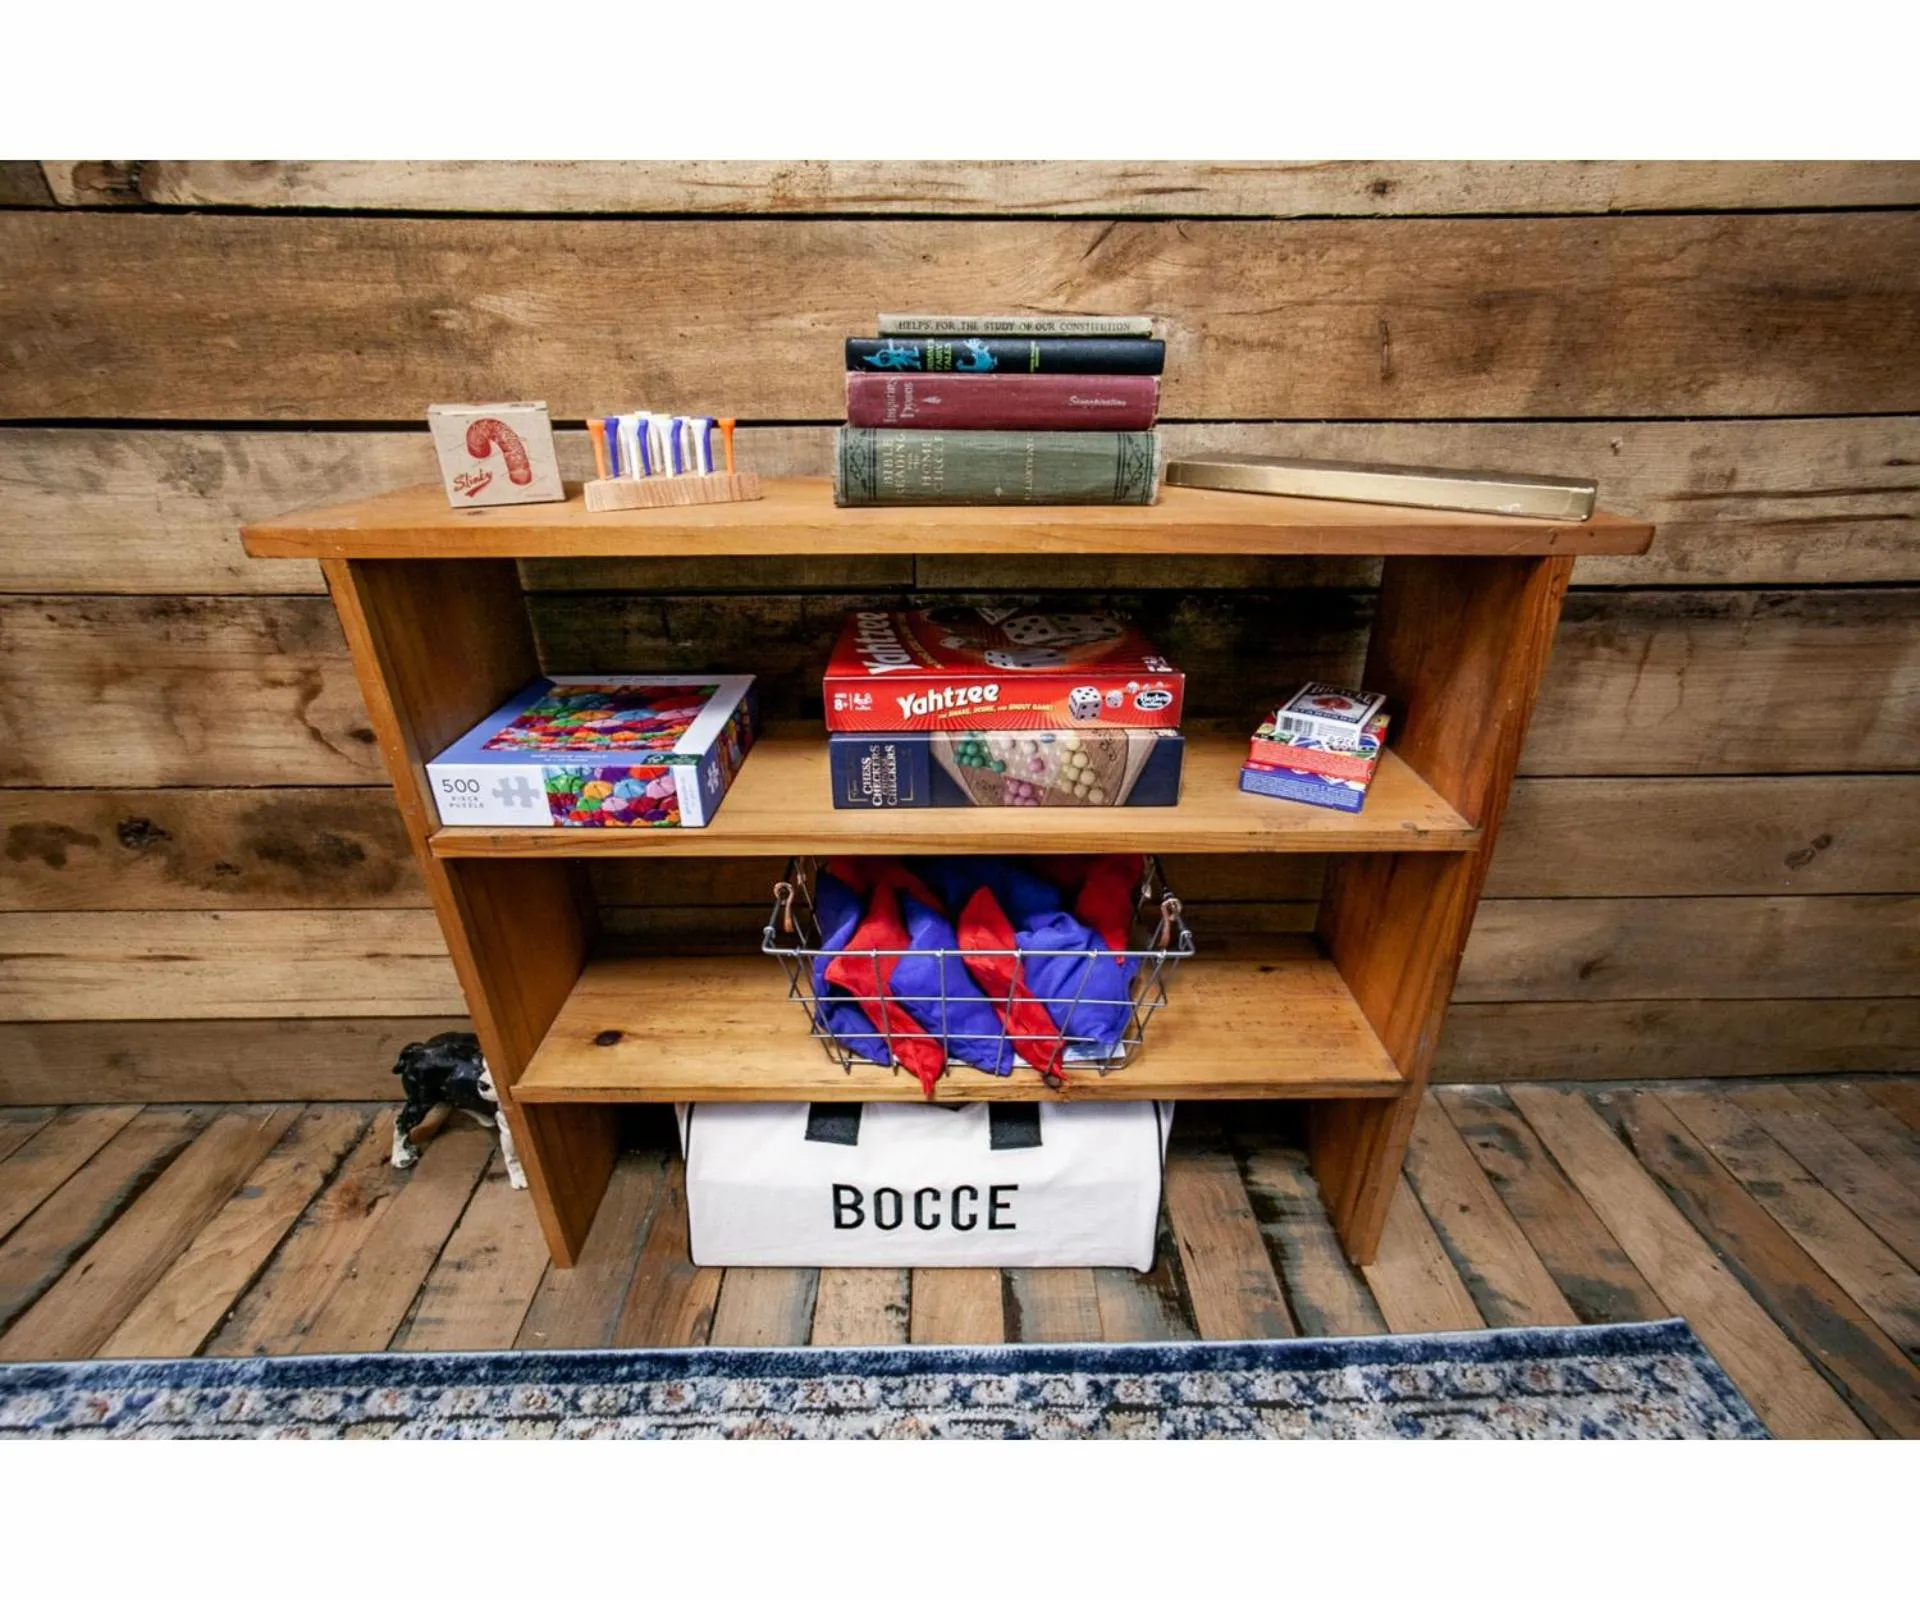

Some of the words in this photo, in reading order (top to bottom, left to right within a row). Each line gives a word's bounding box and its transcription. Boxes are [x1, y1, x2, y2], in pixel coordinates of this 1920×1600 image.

[898, 321, 931, 332] HELPS
[935, 321, 956, 332] FOR
[960, 321, 978, 332] THE
[984, 321, 1014, 332] STUDY
[1019, 321, 1032, 332] OF
[1035, 321, 1055, 332] OUR
[1059, 321, 1131, 332] CONSTITUTION
[883, 438, 893, 485] BIBLE
[921, 439, 932, 487] HOME
[854, 612, 923, 675] Yahtzee
[896, 683, 999, 721] Yahtzee
[441, 778, 481, 793] 500
[861, 757, 873, 795] CHESS
[870, 744, 883, 806] CHECKERS
[885, 744, 898, 806] CHECKERS
[832, 1183, 1019, 1231] BOCCE
